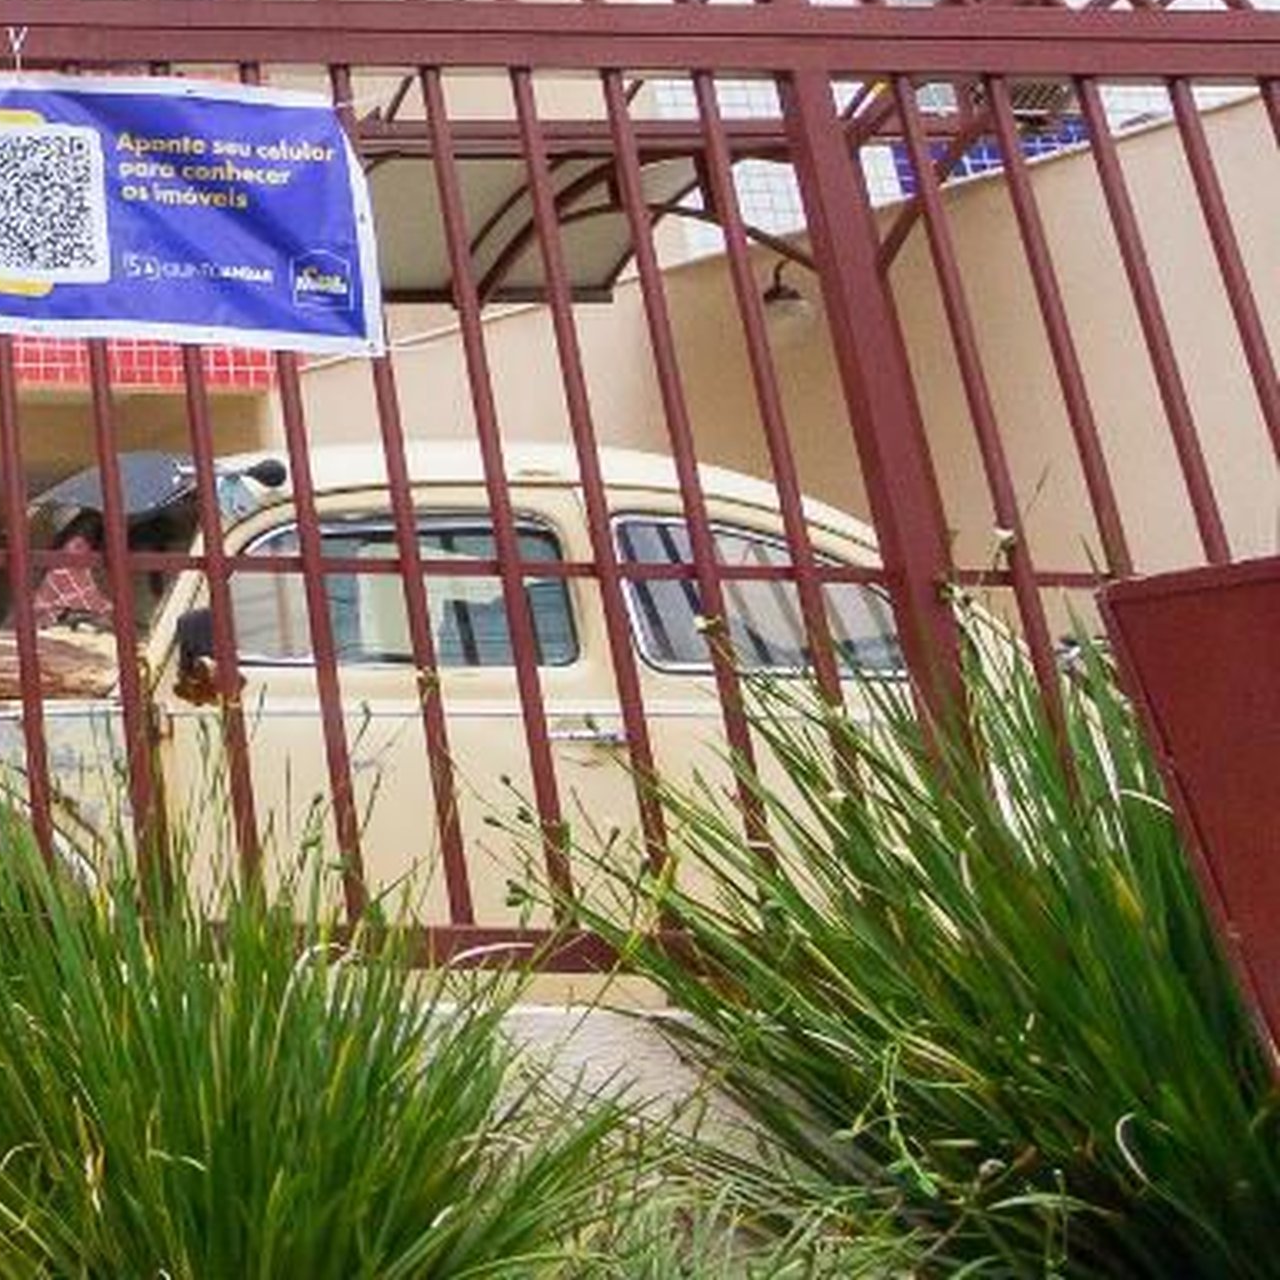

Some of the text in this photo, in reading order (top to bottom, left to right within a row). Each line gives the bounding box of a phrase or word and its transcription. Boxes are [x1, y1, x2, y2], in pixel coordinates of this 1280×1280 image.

[116, 132, 335, 162] Aponte seu celular
[118, 159, 291, 185] para conhecer
[121, 181, 248, 208] os imóveis
